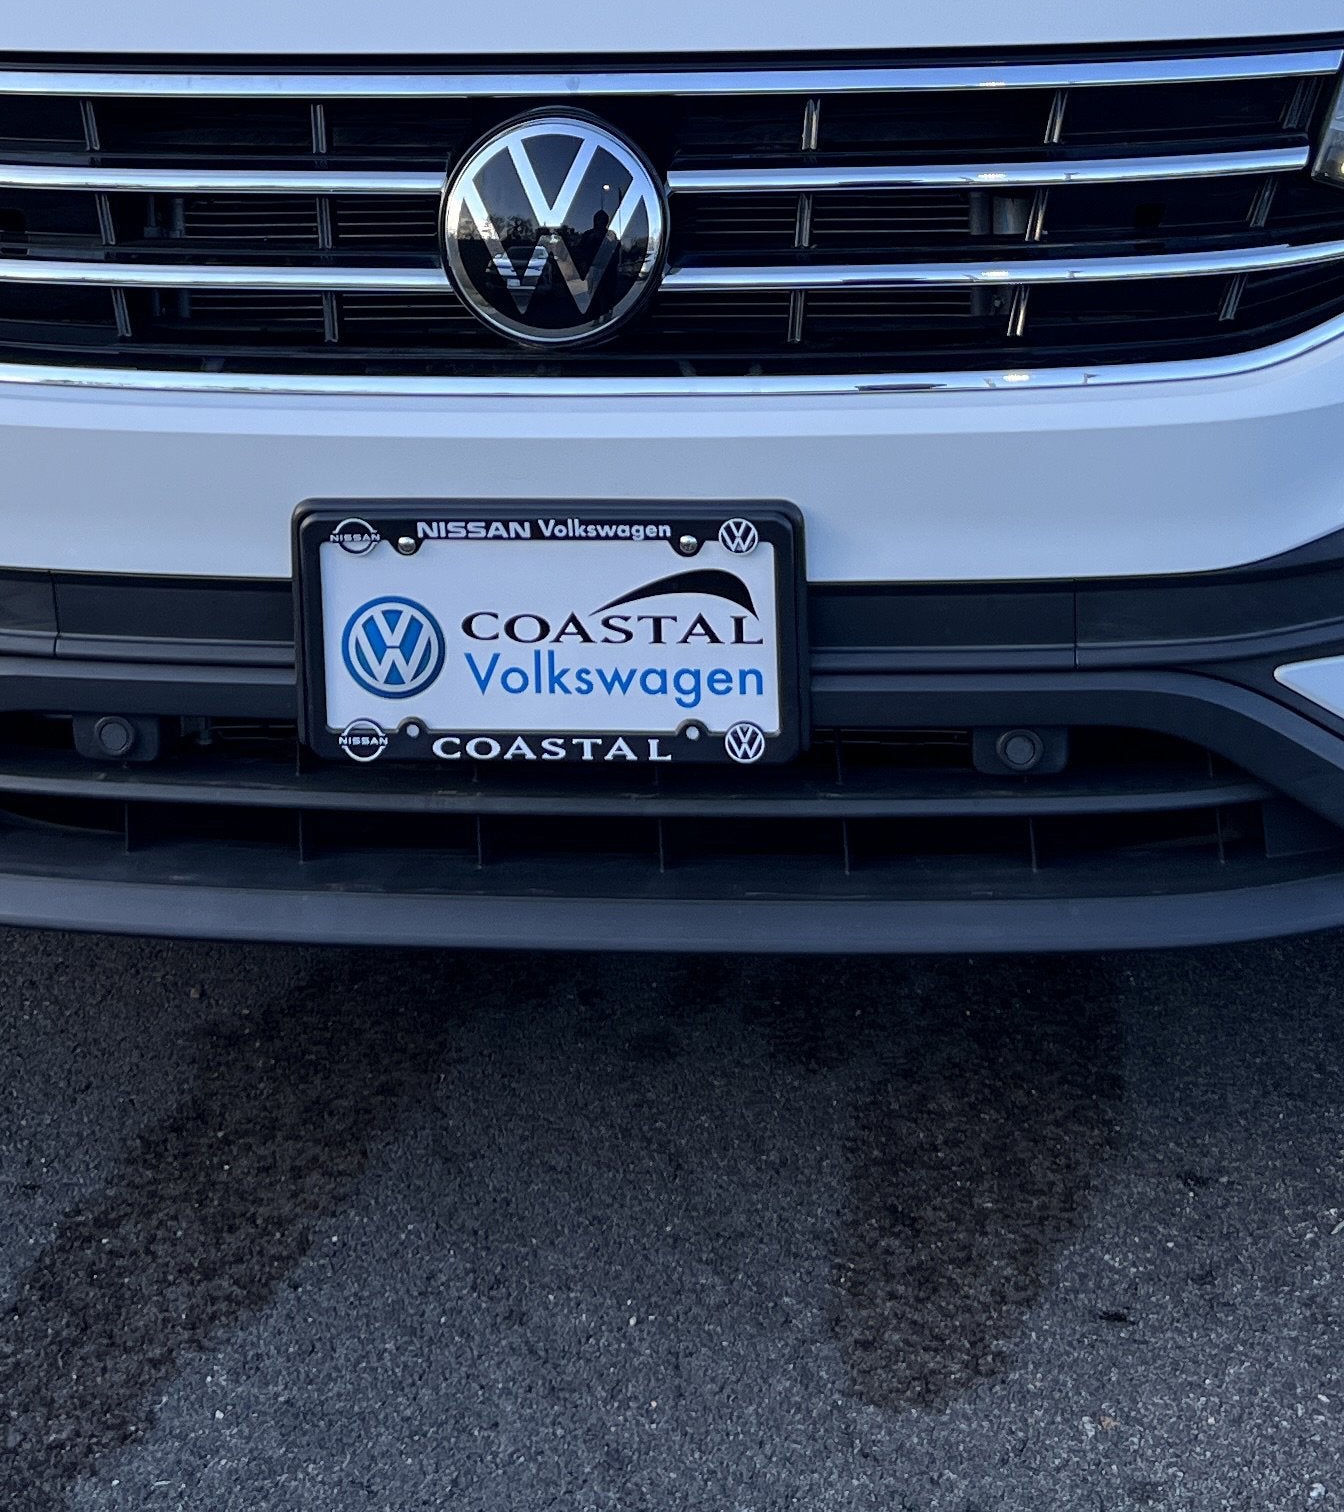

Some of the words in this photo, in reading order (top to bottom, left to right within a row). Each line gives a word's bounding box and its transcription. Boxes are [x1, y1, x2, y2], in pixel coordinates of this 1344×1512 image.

[329, 533, 381, 543] NISSAN
[416, 520, 531, 539] NISSAN
[537, 518, 672, 542] Volkswagen
[460, 611, 764, 645] COASTAL
[463, 648, 764, 709] Volkswagen
[338, 736, 389, 746] NISSAN
[431, 736, 672, 760] COASTAL
